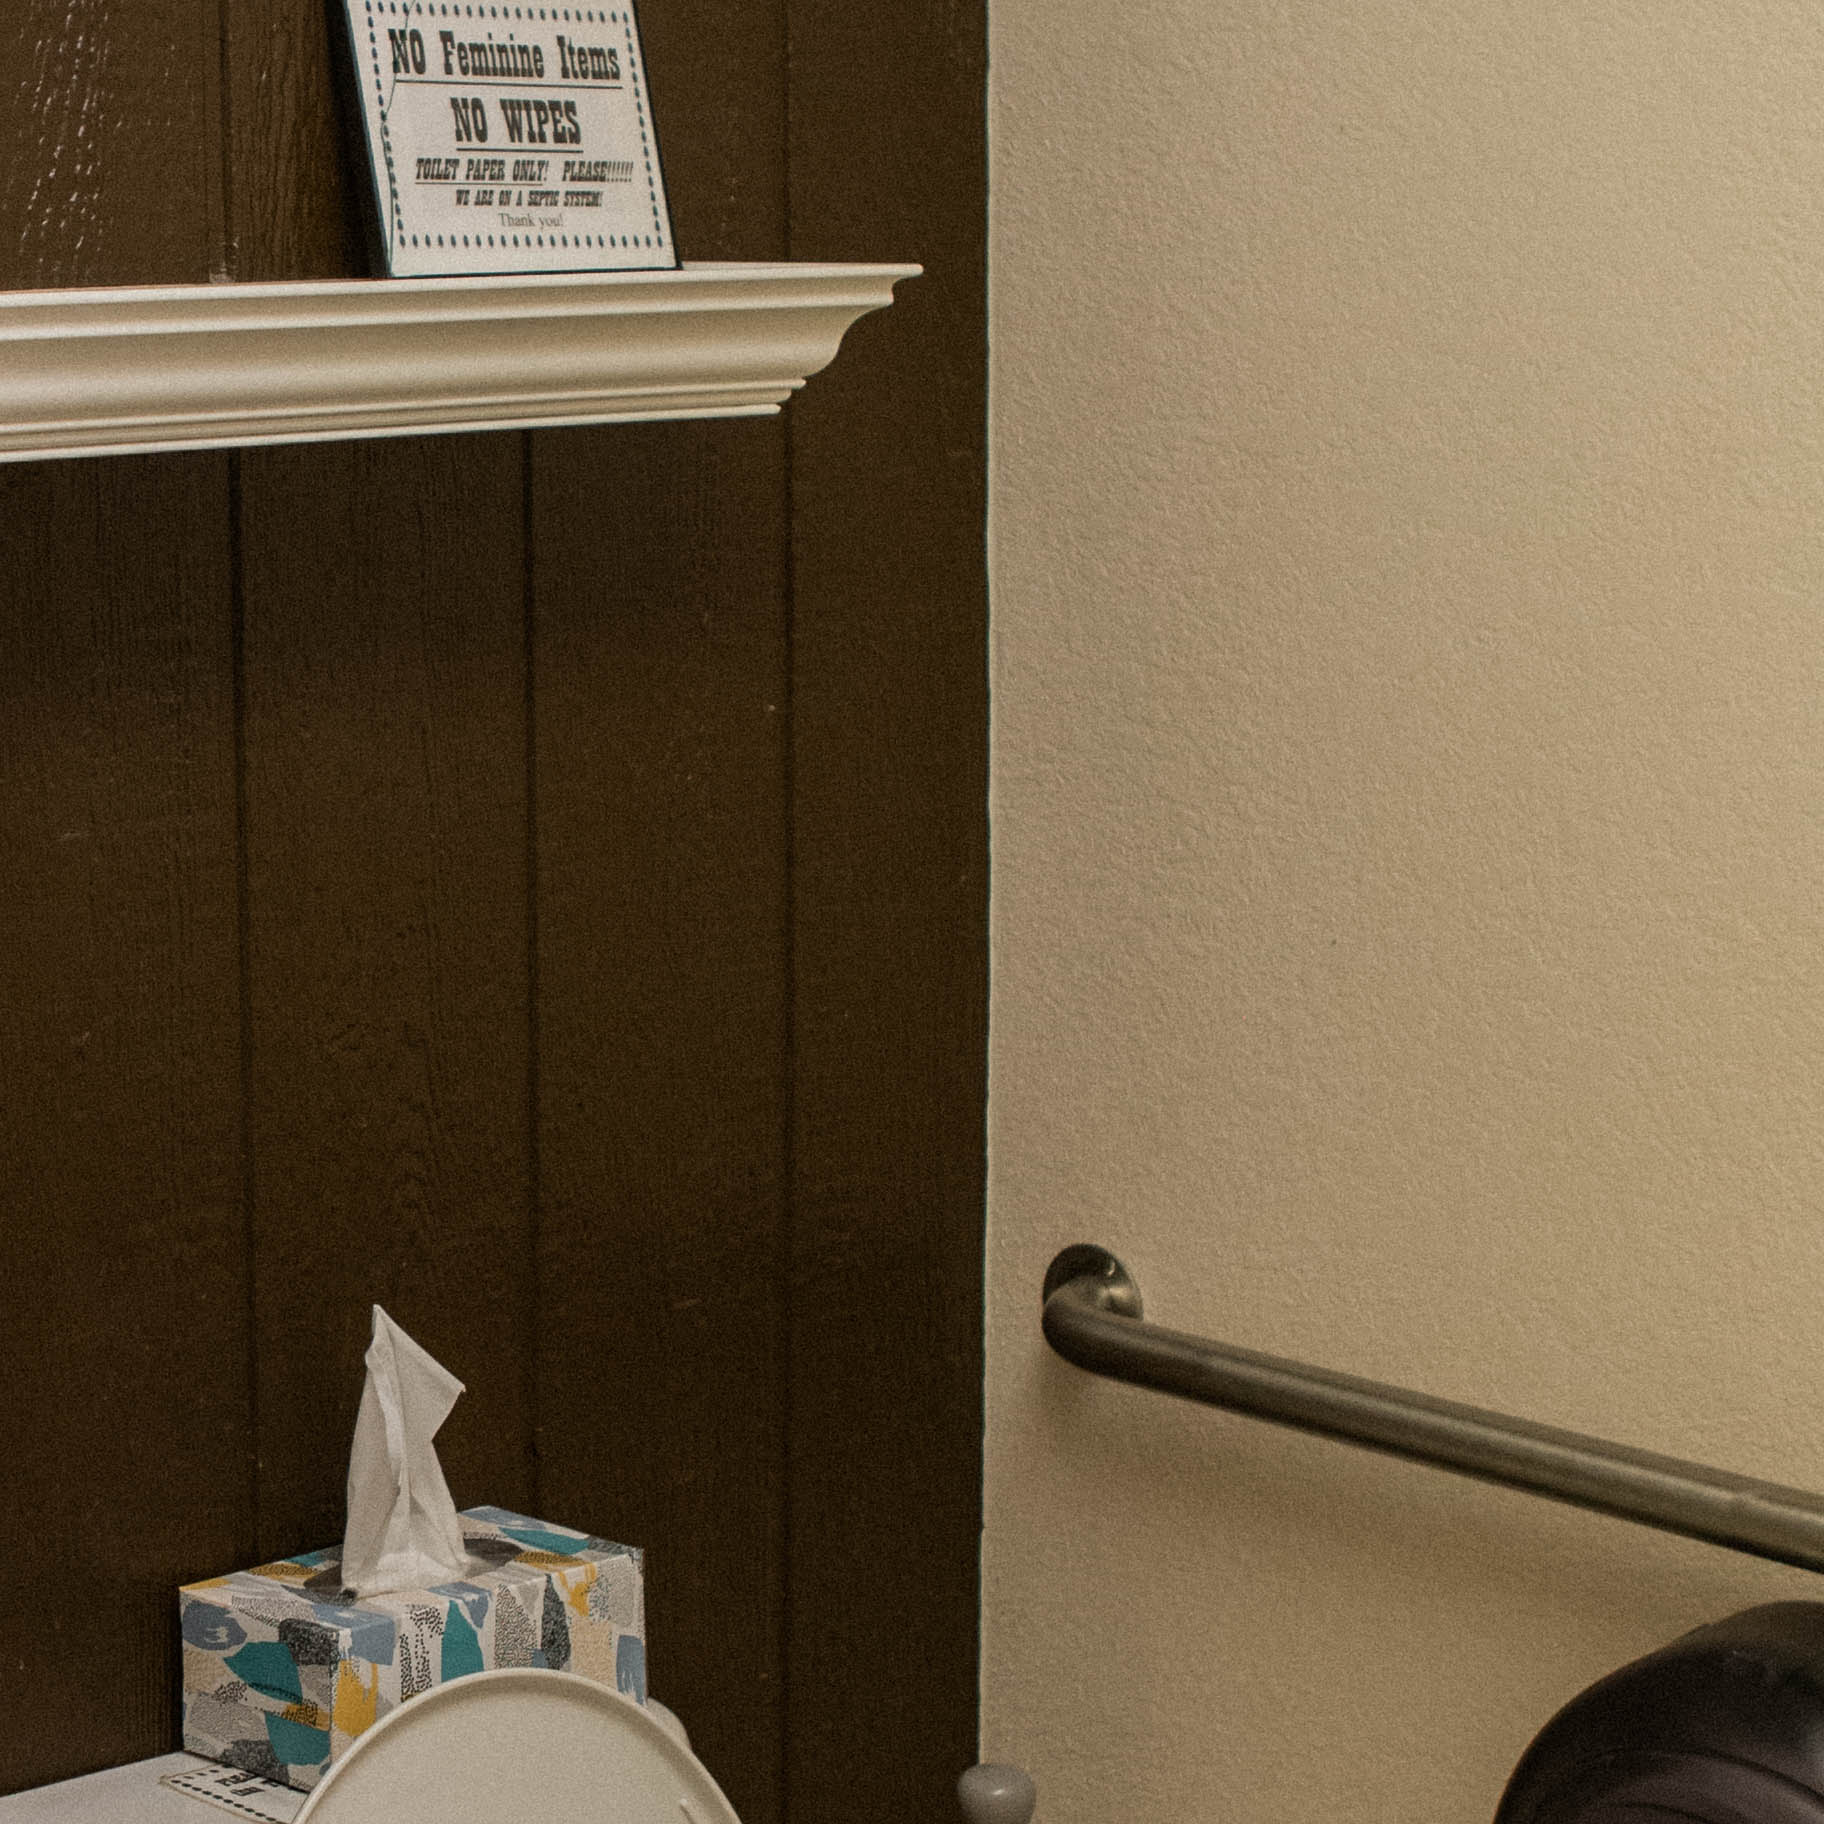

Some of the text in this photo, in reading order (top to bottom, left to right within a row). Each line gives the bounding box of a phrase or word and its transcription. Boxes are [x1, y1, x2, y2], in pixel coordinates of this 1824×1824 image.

[387, 28, 621, 80] NO Feminine Items
[450, 97, 582, 145] NO WIPES
[415, 158, 460, 181] TOILET
[466, 159, 506, 181] PAPER
[513, 160, 549, 182] ONLY!
[455, 190, 603, 207] WE ARE ON A SEPTIC SYSTEM!
[498, 212, 564, 229] Thank you!
